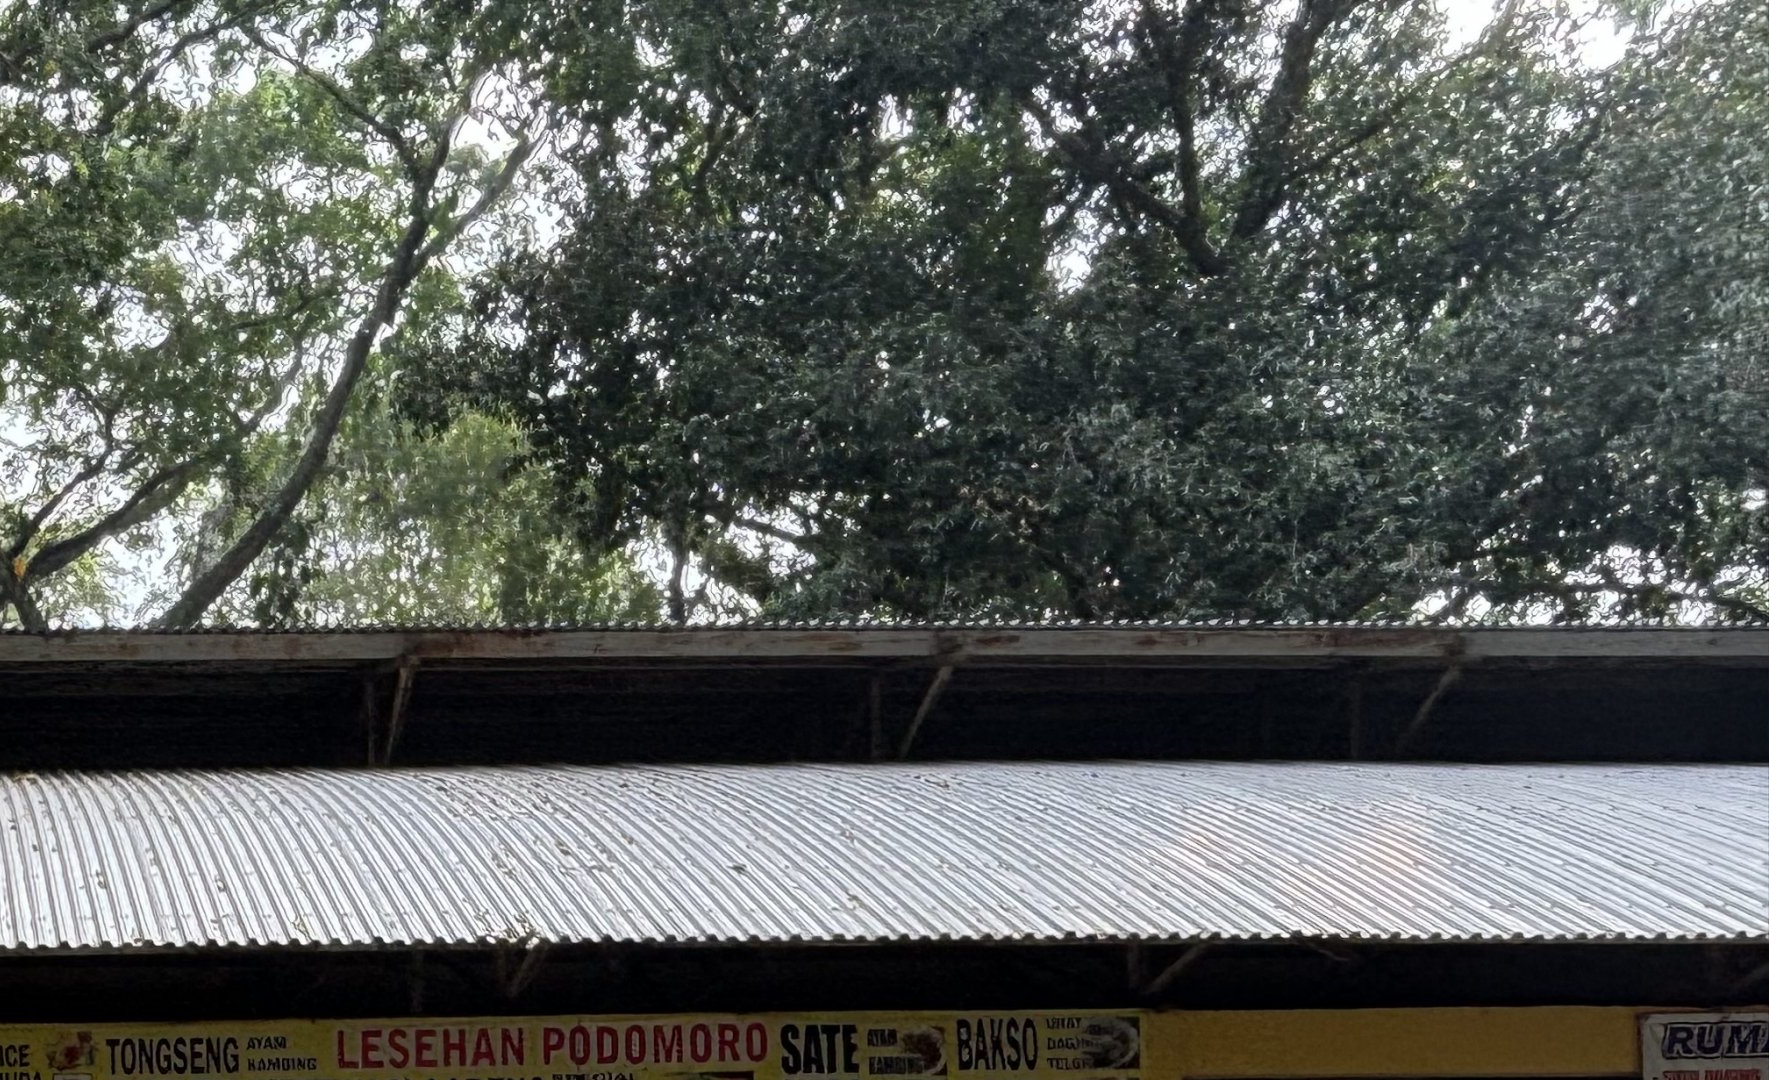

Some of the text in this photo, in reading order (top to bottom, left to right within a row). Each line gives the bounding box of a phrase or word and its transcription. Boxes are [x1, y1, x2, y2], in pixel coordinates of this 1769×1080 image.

[106, 1037, 239, 1074] TONGSENG
[246, 1037, 288, 1050] AYAM
[337, 1023, 768, 1069] LESEHAN PODOMORO
[781, 1024, 860, 1075] SATE
[956, 1018, 1038, 1071] BAKSO
[247, 1058, 317, 1071] KAMBING
